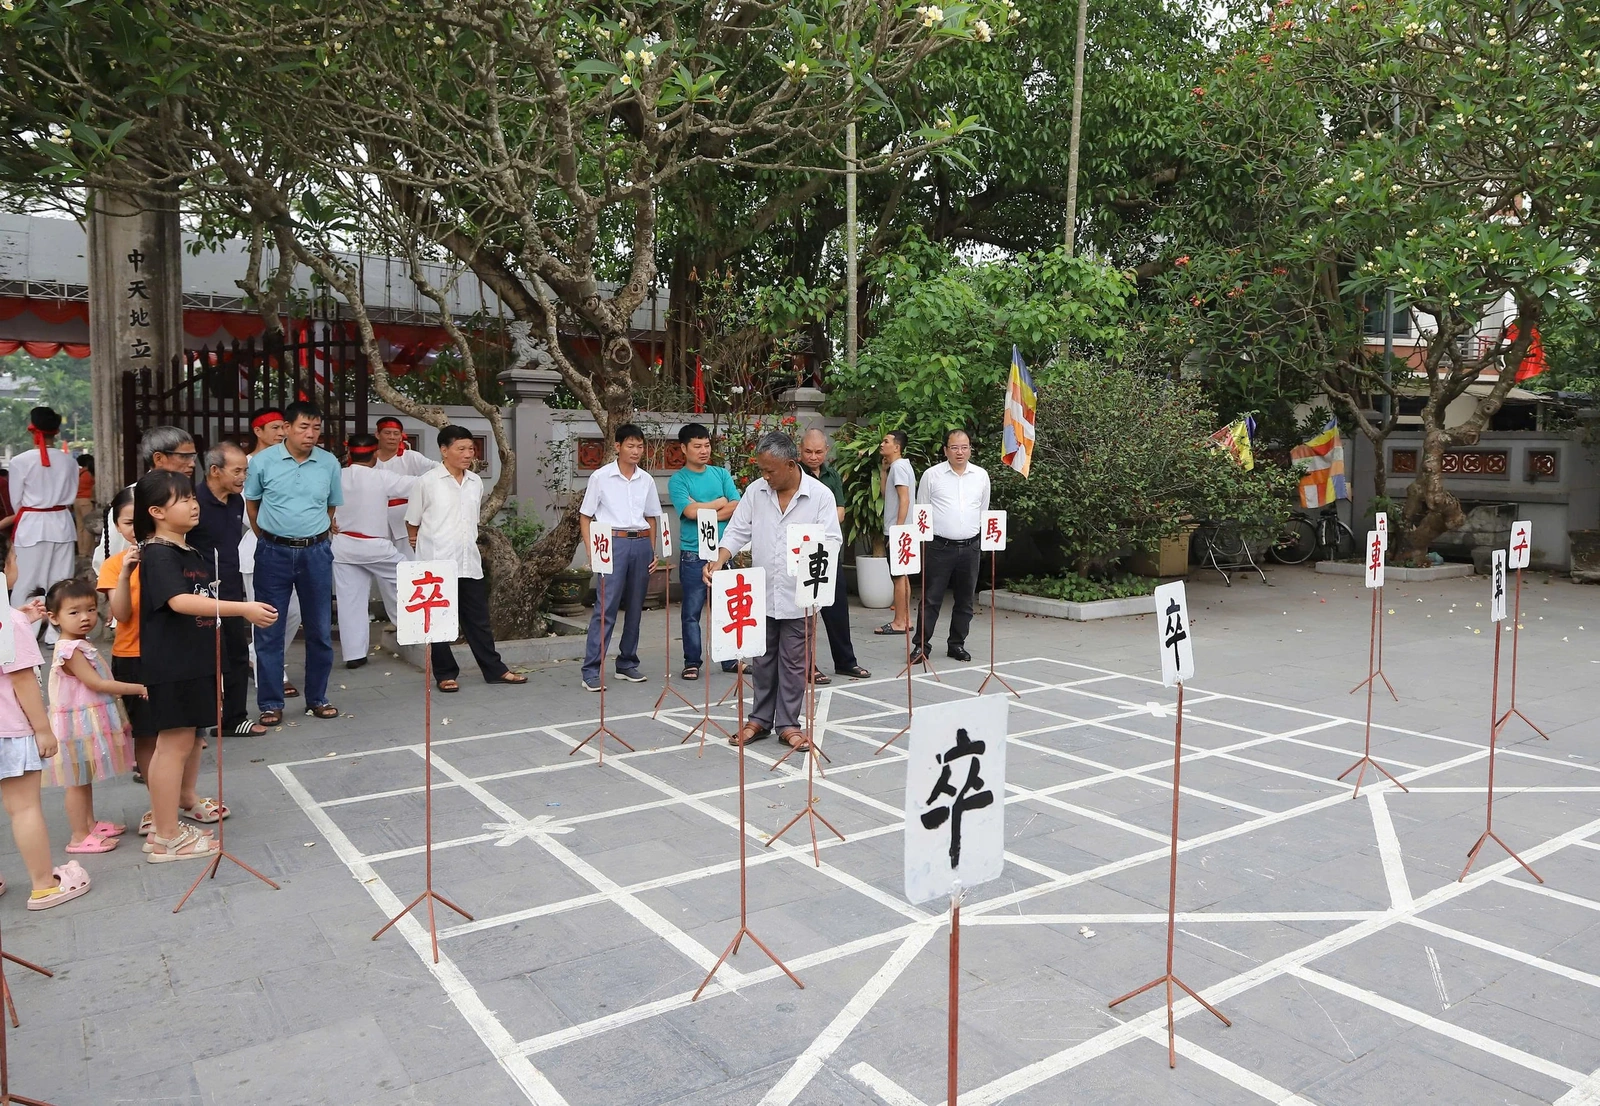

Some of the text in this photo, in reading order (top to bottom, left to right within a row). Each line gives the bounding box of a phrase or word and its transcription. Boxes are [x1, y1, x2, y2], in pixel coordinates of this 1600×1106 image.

[663, 521, 670, 546] 士
[701, 520, 717, 551] 炮
[917, 509, 930, 534] 象
[985, 518, 1003, 543] 馬
[593, 533, 611, 564] 炮
[898, 532, 916, 566] 象
[1369, 534, 1381, 581] 車
[803, 542, 829, 600] 車
[405, 570, 450, 634] 卒
[722, 573, 758, 649] 車
[1165, 597, 1187, 672] 卒
[920, 728, 994, 869] 卒
